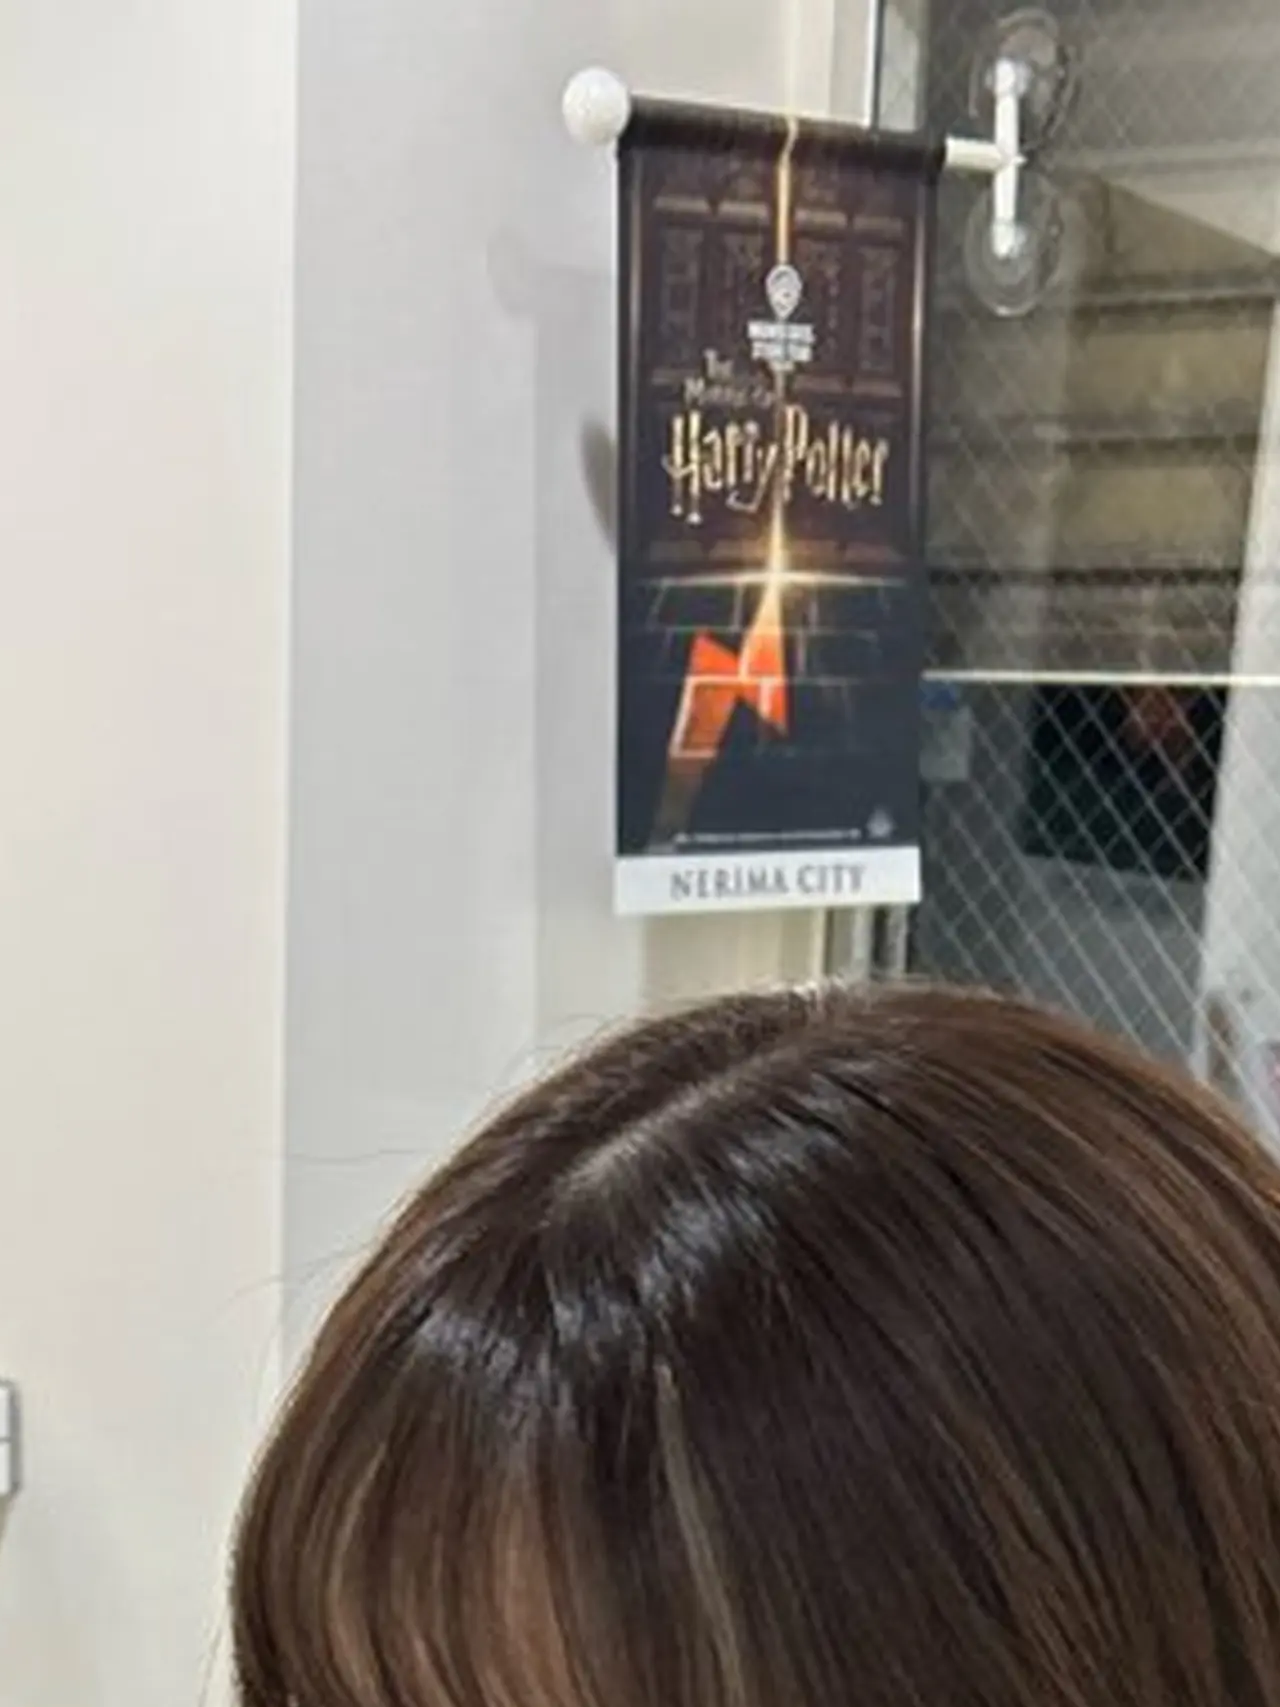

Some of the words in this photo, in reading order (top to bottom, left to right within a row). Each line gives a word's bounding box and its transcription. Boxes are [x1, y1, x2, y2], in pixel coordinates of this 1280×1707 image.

[661, 410, 779, 525] Harry
[782, 404, 890, 508] Potter
[670, 863, 790, 900] NERIMA
[796, 862, 867, 895] CITY
